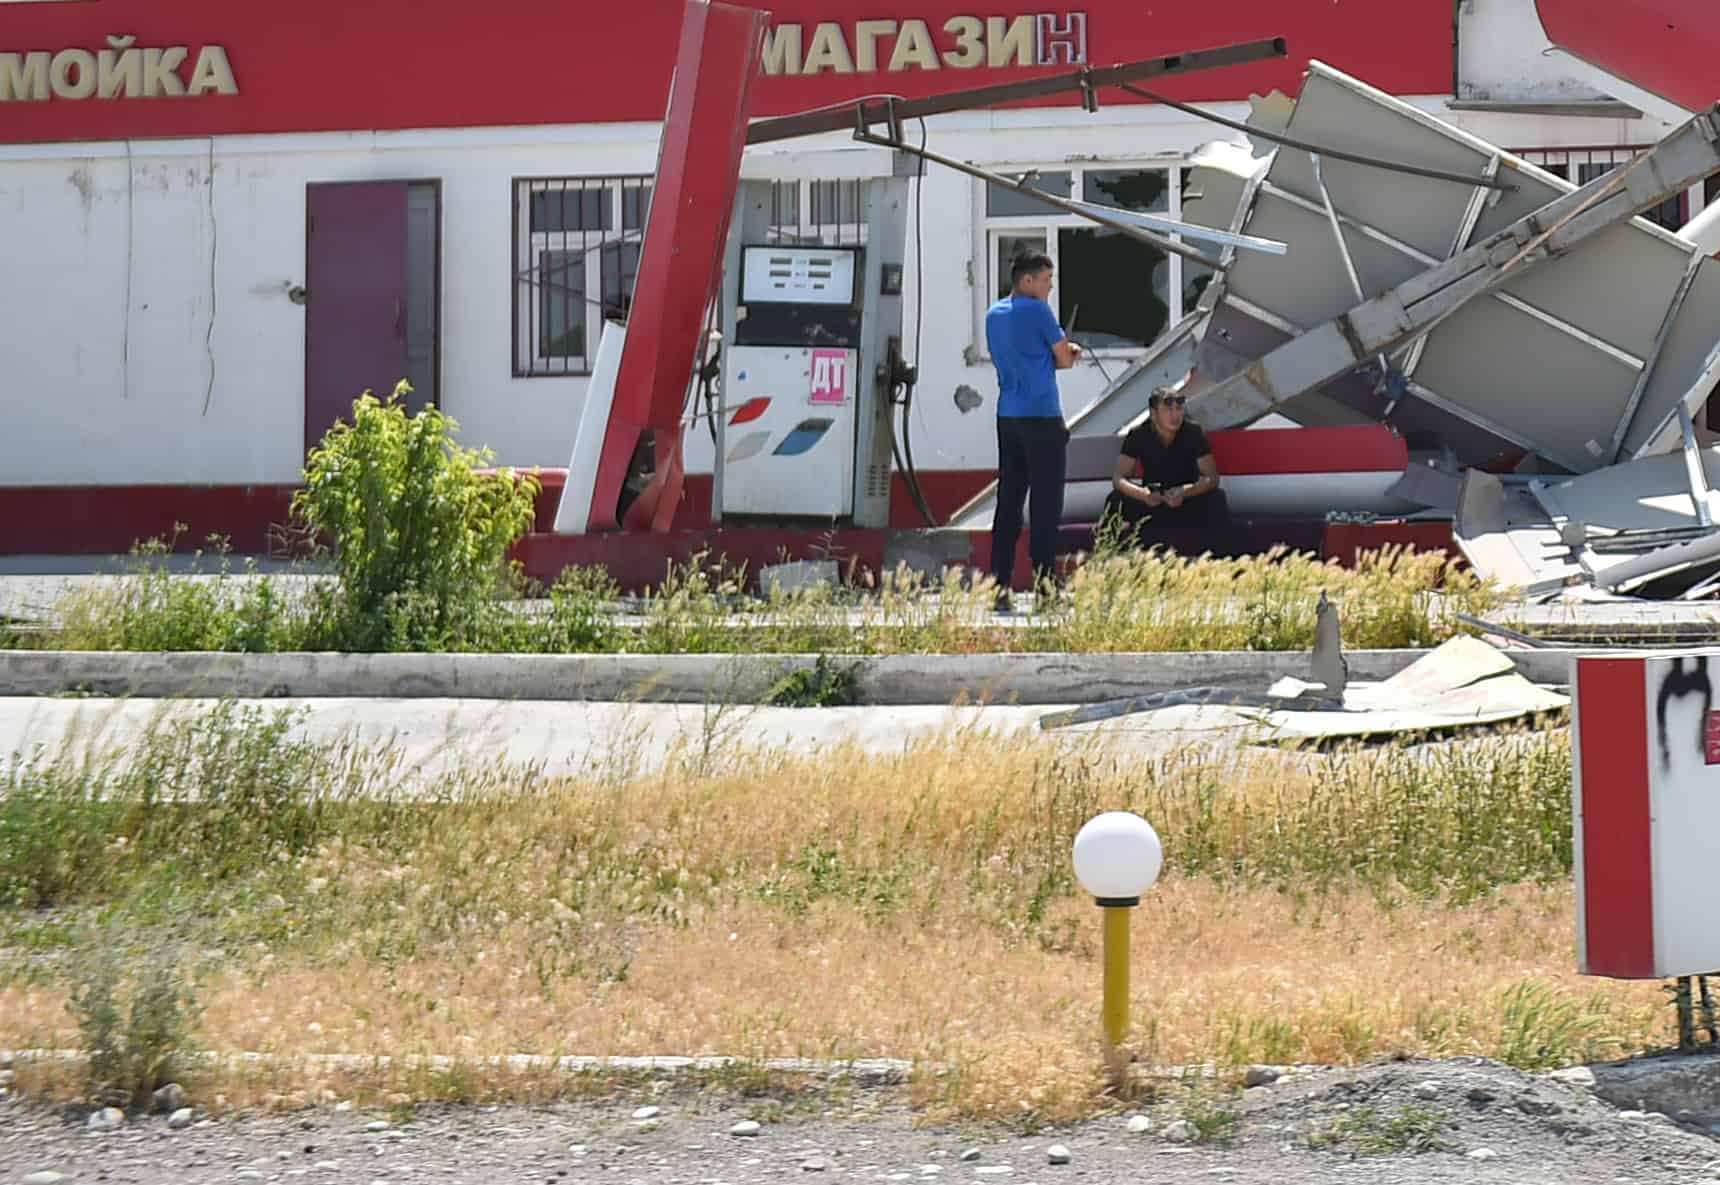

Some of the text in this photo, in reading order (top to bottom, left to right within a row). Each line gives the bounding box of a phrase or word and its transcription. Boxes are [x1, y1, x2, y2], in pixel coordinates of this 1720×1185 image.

[0, 34, 239, 102] МОЙКА
[760, 12, 1087, 75] МАГАЗИН
[811, 357, 844, 392] ДТ
